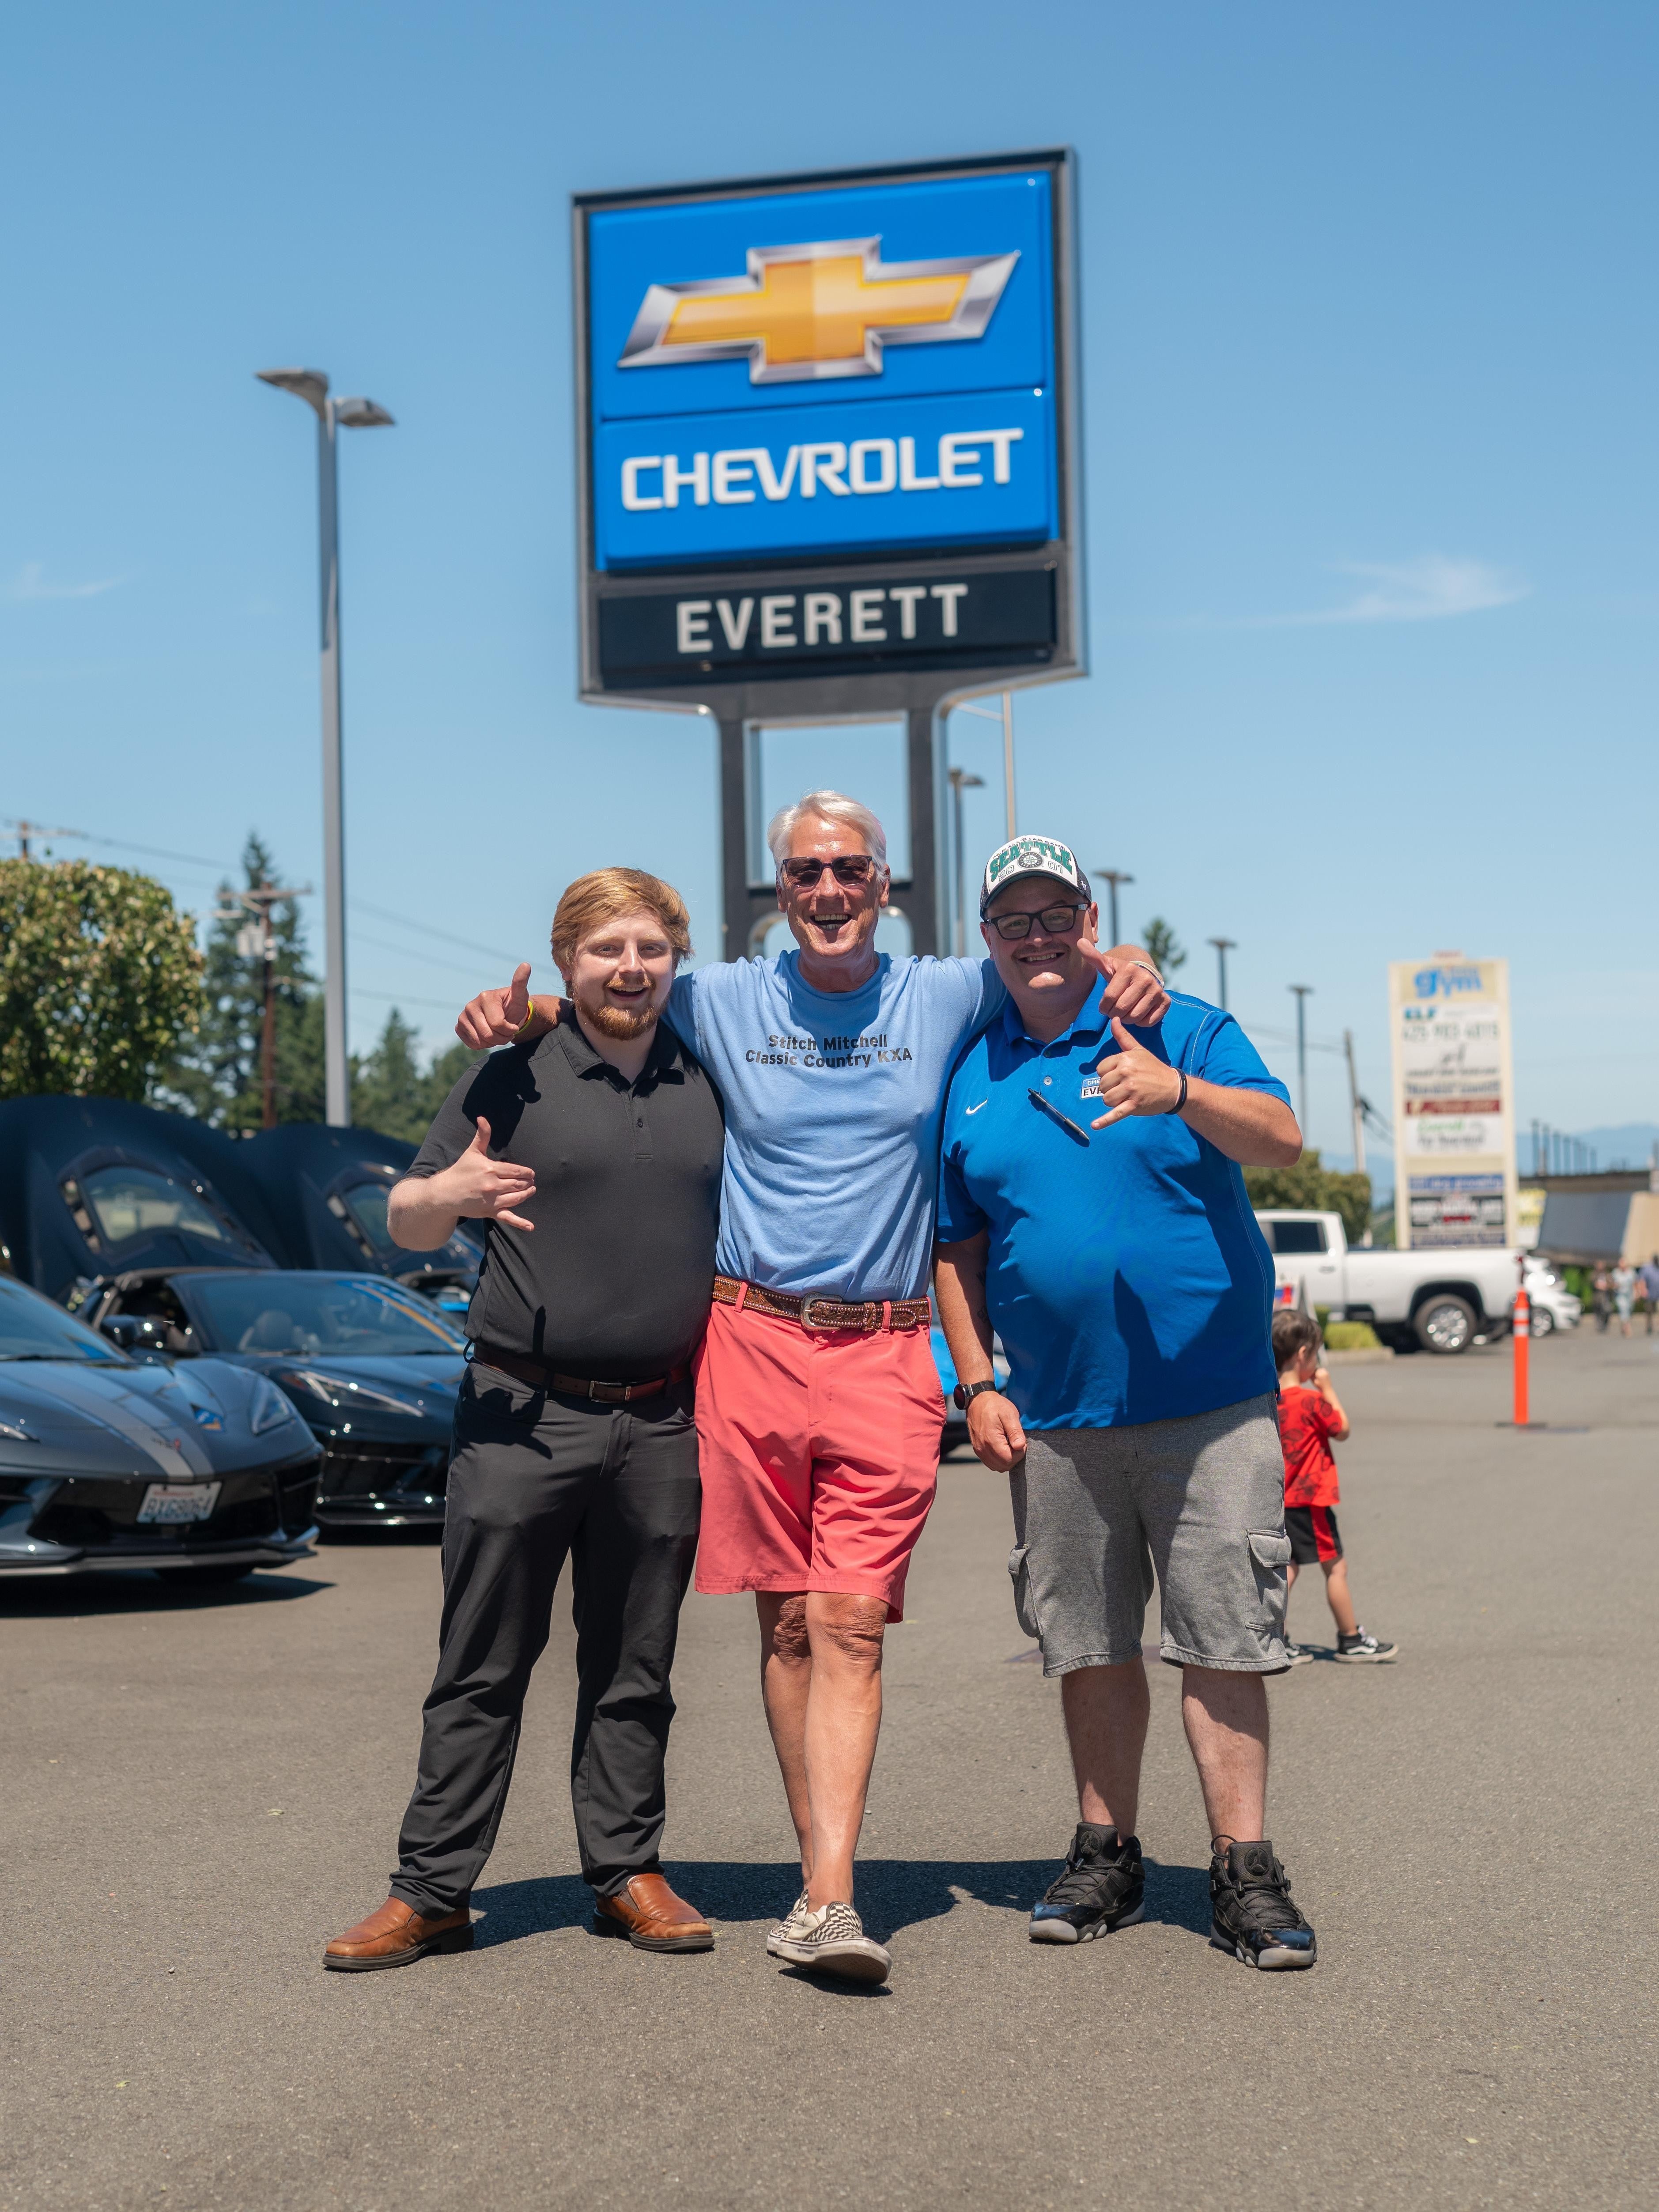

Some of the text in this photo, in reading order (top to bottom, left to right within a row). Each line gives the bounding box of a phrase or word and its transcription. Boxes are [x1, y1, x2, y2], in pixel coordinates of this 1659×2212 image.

[621, 427, 1024, 511] CHEVROLET
[676, 583, 968, 654] EVERETT
[990, 840, 1073, 882] SEATTLE
[746, 1047, 913, 1068] Classic Country KXA
[769, 1034, 888, 1051] Stitch Mitchell
